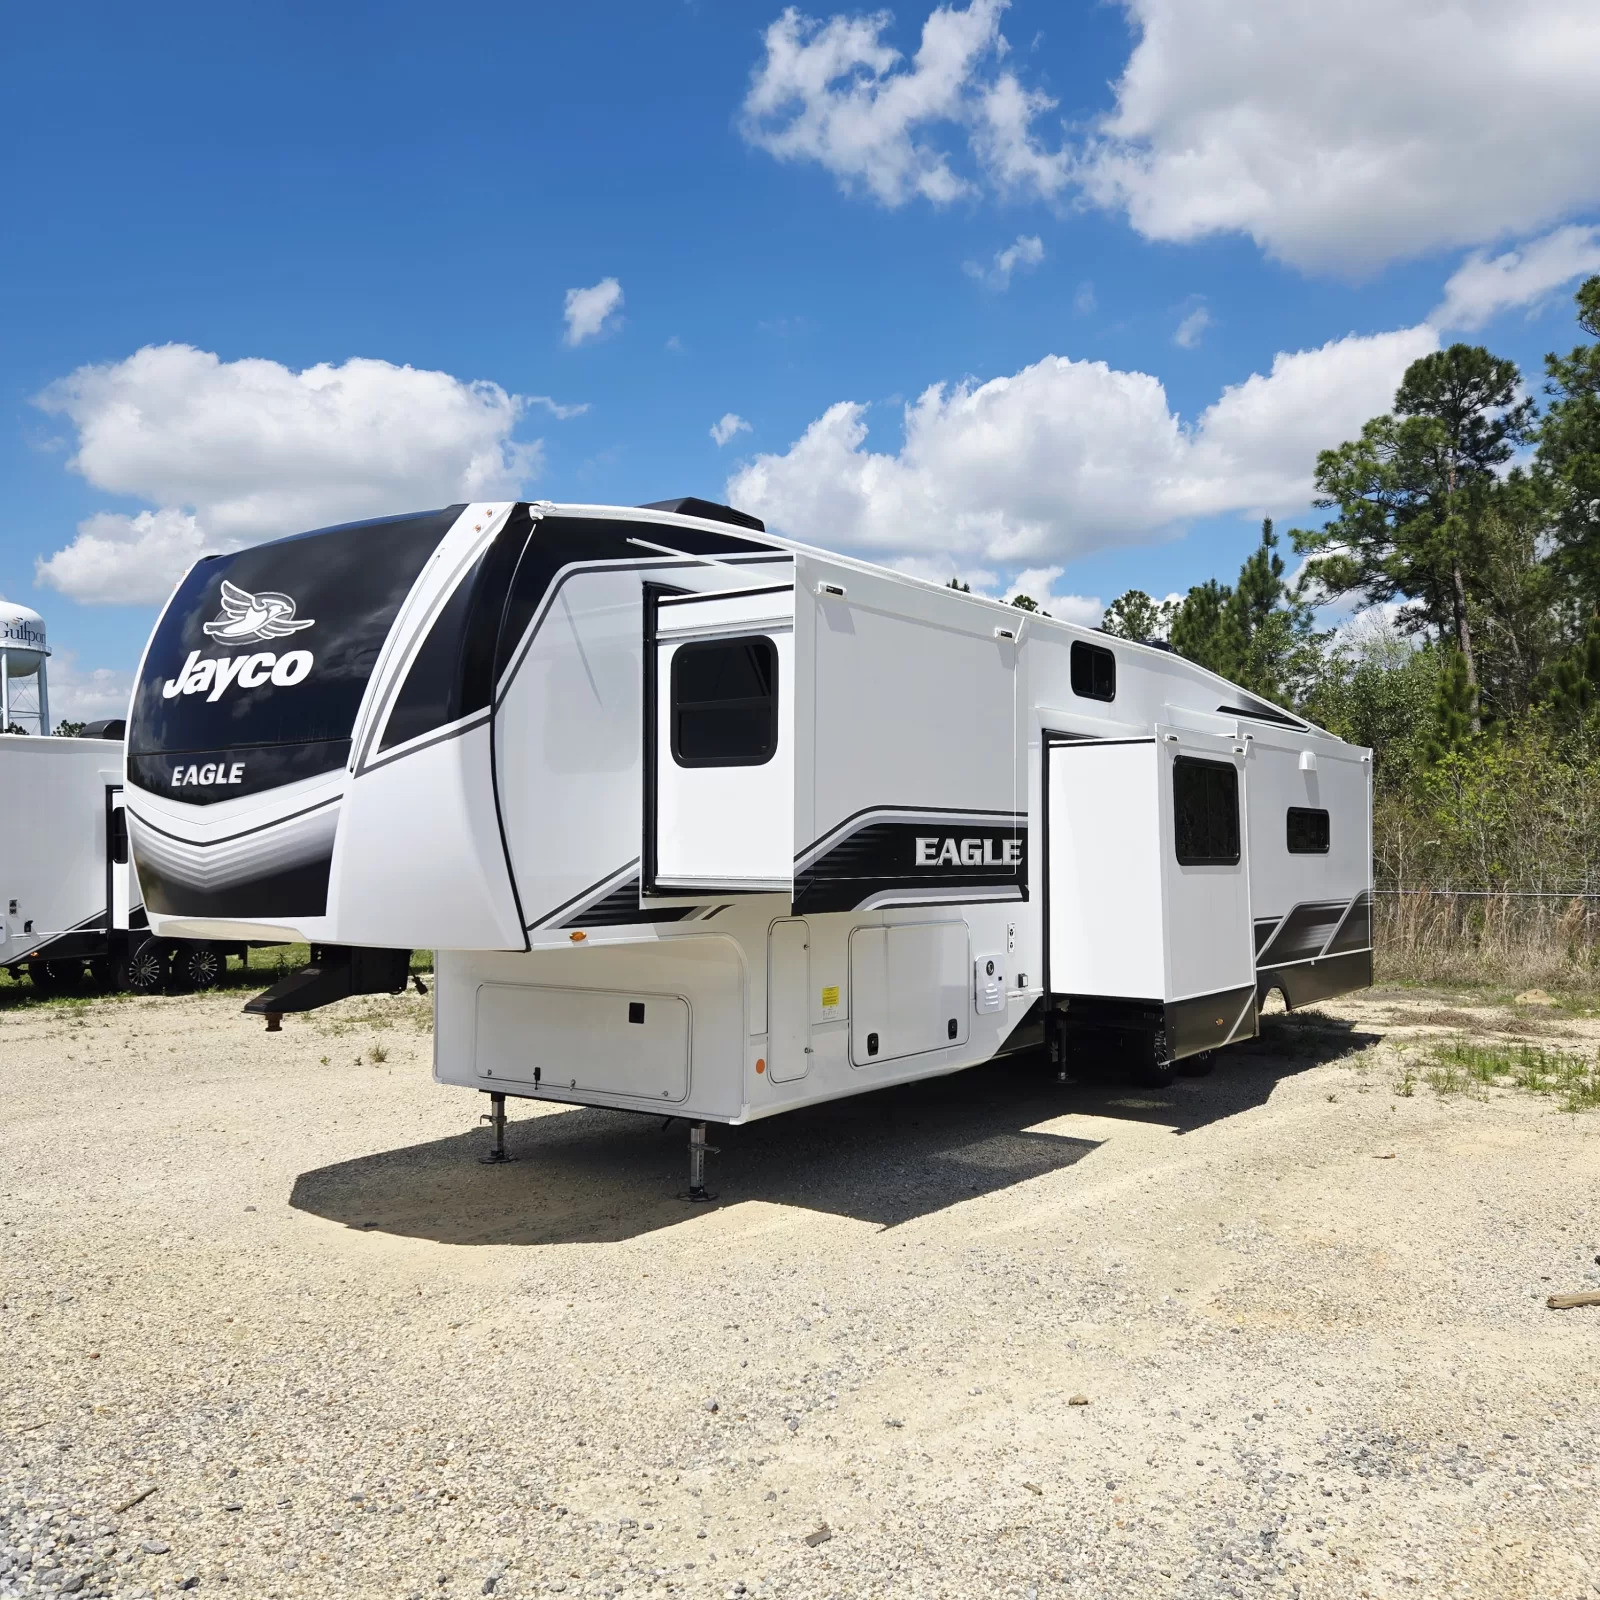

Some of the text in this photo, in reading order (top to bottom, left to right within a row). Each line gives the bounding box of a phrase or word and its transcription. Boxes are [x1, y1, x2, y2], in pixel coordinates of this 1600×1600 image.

[162, 650, 314, 702] Jayco
[171, 762, 246, 787] EAGLE
[915, 837, 1024, 866] EAGLE
